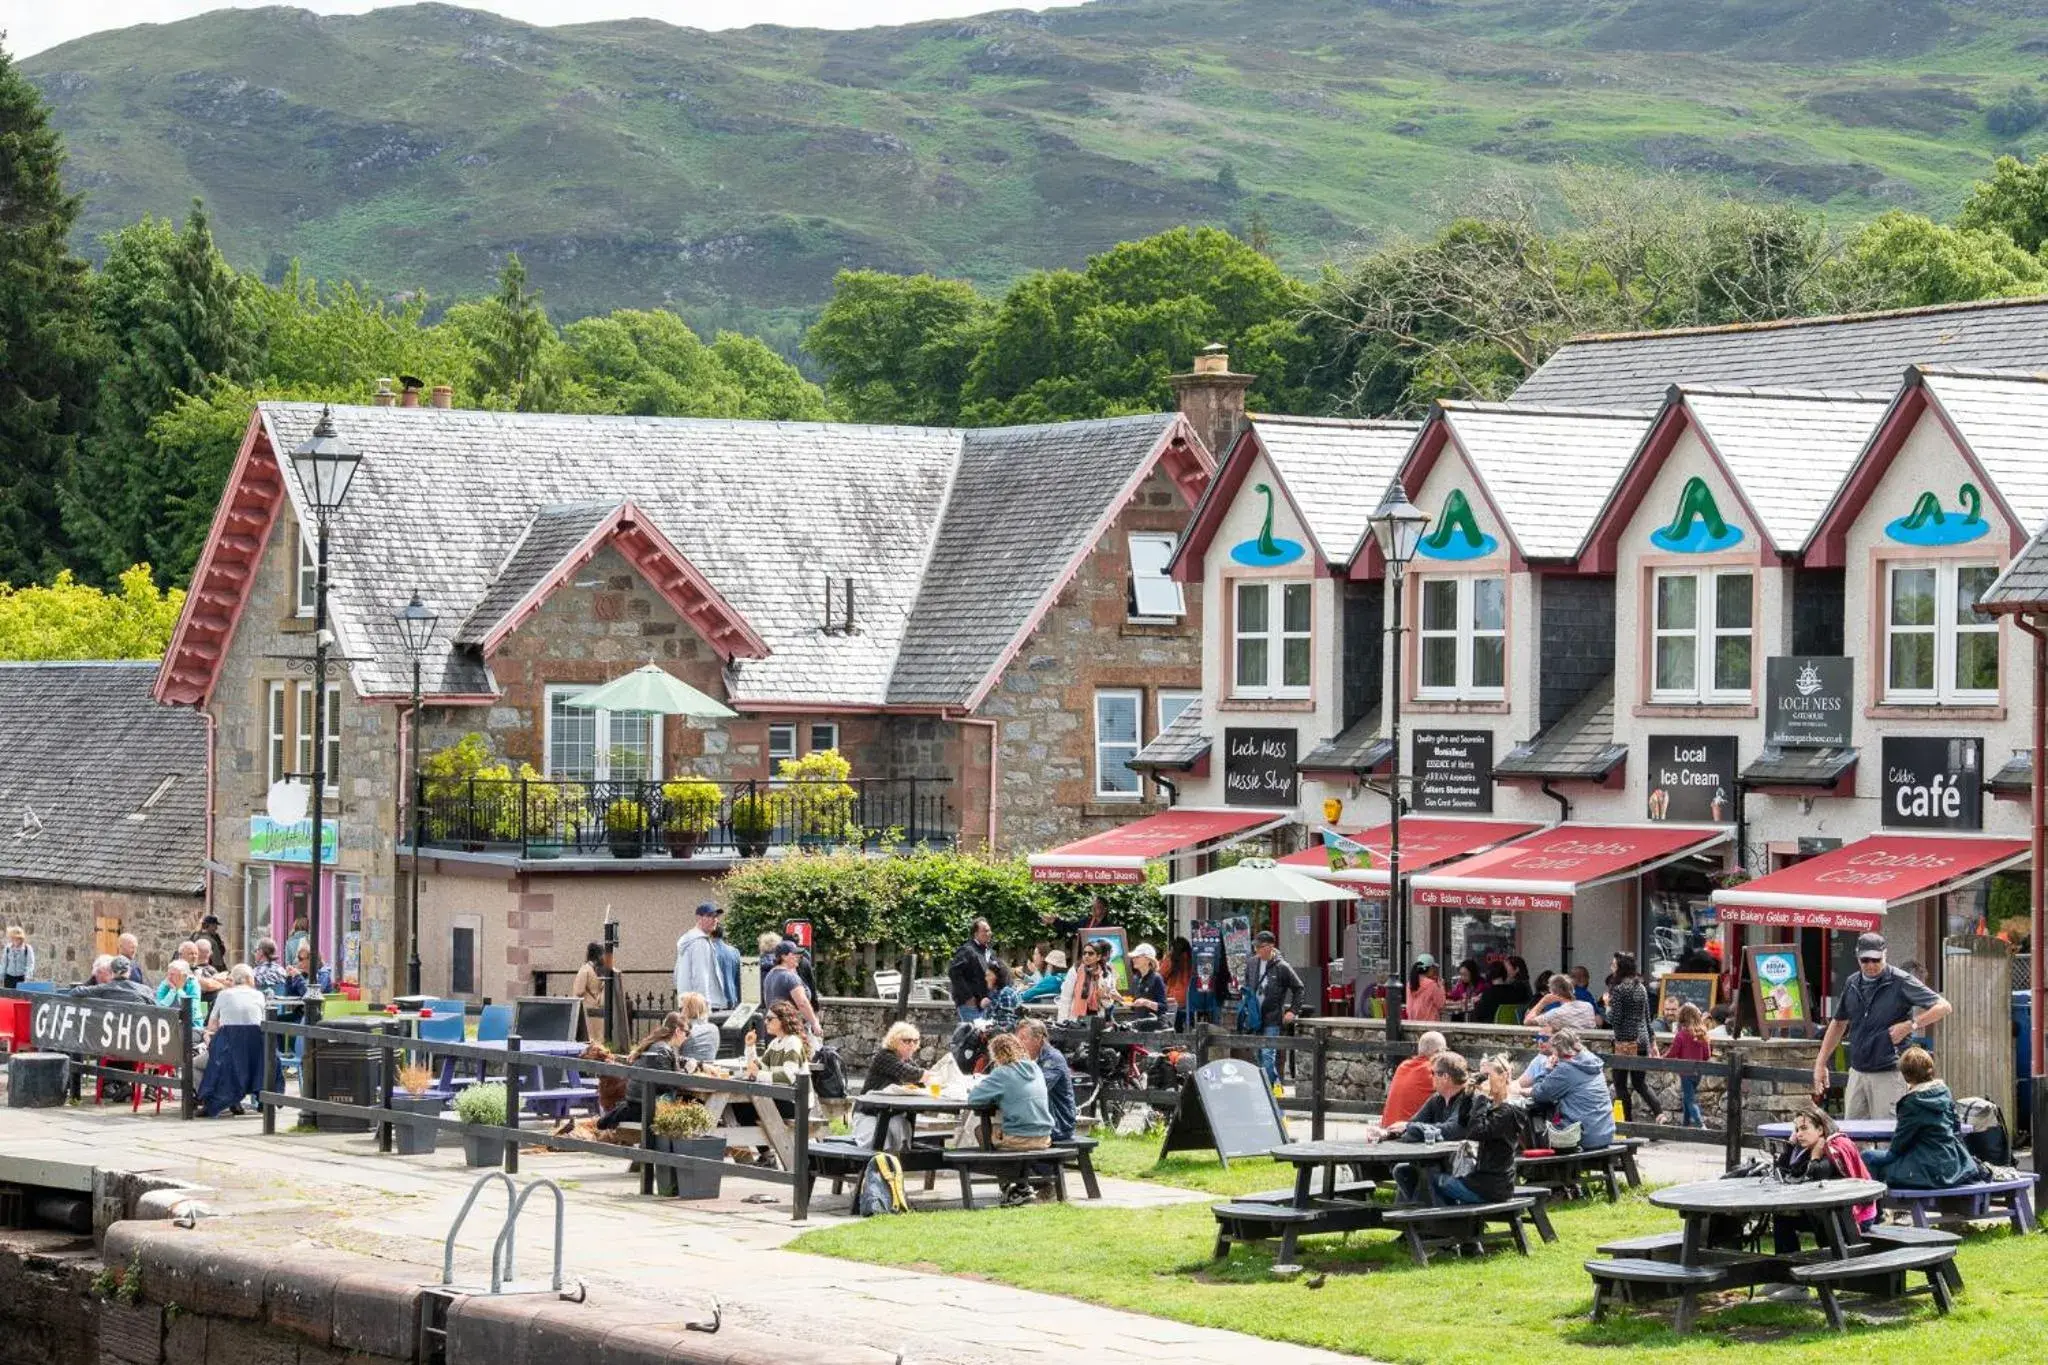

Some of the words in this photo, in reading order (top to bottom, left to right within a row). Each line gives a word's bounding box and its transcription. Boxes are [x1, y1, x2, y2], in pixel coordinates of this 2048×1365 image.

[1778, 696, 1809, 710] LOCH
[1813, 697, 1841, 711] NESS
[1232, 736, 1260, 756] Loch
[1261, 738, 1287, 759] Ness
[1449, 735, 1460, 744] and
[1674, 745, 1706, 762] Local
[1228, 767, 1261, 790] Nessie
[1263, 769, 1291, 798] Shop
[1660, 768, 1679, 785] Ice
[1681, 769, 1720, 786] Cream
[1896, 773, 1961, 818] café
[1847, 851, 1955, 868] Cobbs
[1422, 892, 1437, 903] Cafe
[1505, 896, 1526, 906] Coffee
[1530, 896, 1562, 910] Takeaway
[1721, 908, 1739, 920] Cafe
[1740, 909, 1765, 924] Bakery
[1766, 911, 1789, 923] Gelato
[1792, 912, 1806, 923] Tea
[1807, 913, 1833, 926] Coffee
[1835, 915, 1874, 930] Takeaway
[35, 1003, 91, 1043] GIFT
[101, 1011, 171, 1056] SHOP
